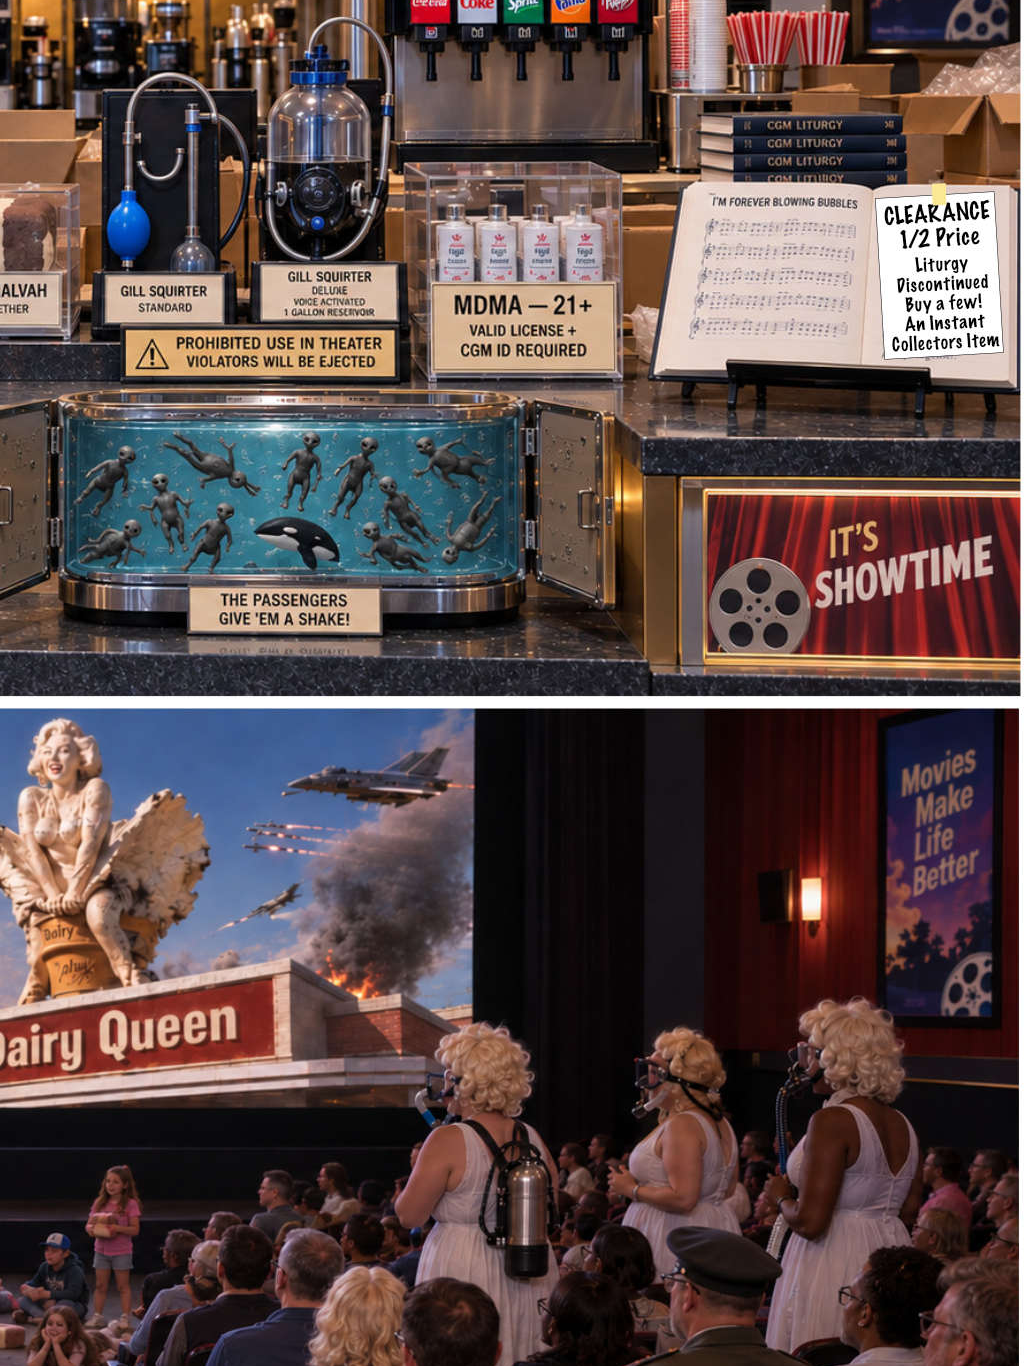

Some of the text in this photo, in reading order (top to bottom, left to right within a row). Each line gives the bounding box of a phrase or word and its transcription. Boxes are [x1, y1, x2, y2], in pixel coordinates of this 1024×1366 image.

[767, 120, 843, 130] CGM LITURGY
[712, 196, 858, 209] I'M FOREVER BLOWING BUBBLES
[884, 200, 990, 225] CLEARANCE
[900, 227, 980, 249] 1/2 Price
[915, 257, 968, 273] Liturgy
[121, 286, 208, 297] GILL SQUIRTER
[897, 274, 988, 293] Discontinued
[138, 303, 193, 313] STANDARD
[905, 293, 982, 314] Buy a few!
[905, 314, 985, 331] An Instant
[176, 337, 382, 350] PROHIBITED USE IN THEATER
[892, 333, 1000, 352] Collectors Item
[187, 355, 376, 368] VIOLATORS WILL BE EJECTED
[829, 520, 879, 560] IT'S
[814, 534, 994, 609] SHOWTIME
[221, 593, 348, 607] THE PASSENGERS
[219, 612, 350, 626] GIVE 'EM A SHAKE!
[98, 1004, 238, 1062] Queen
